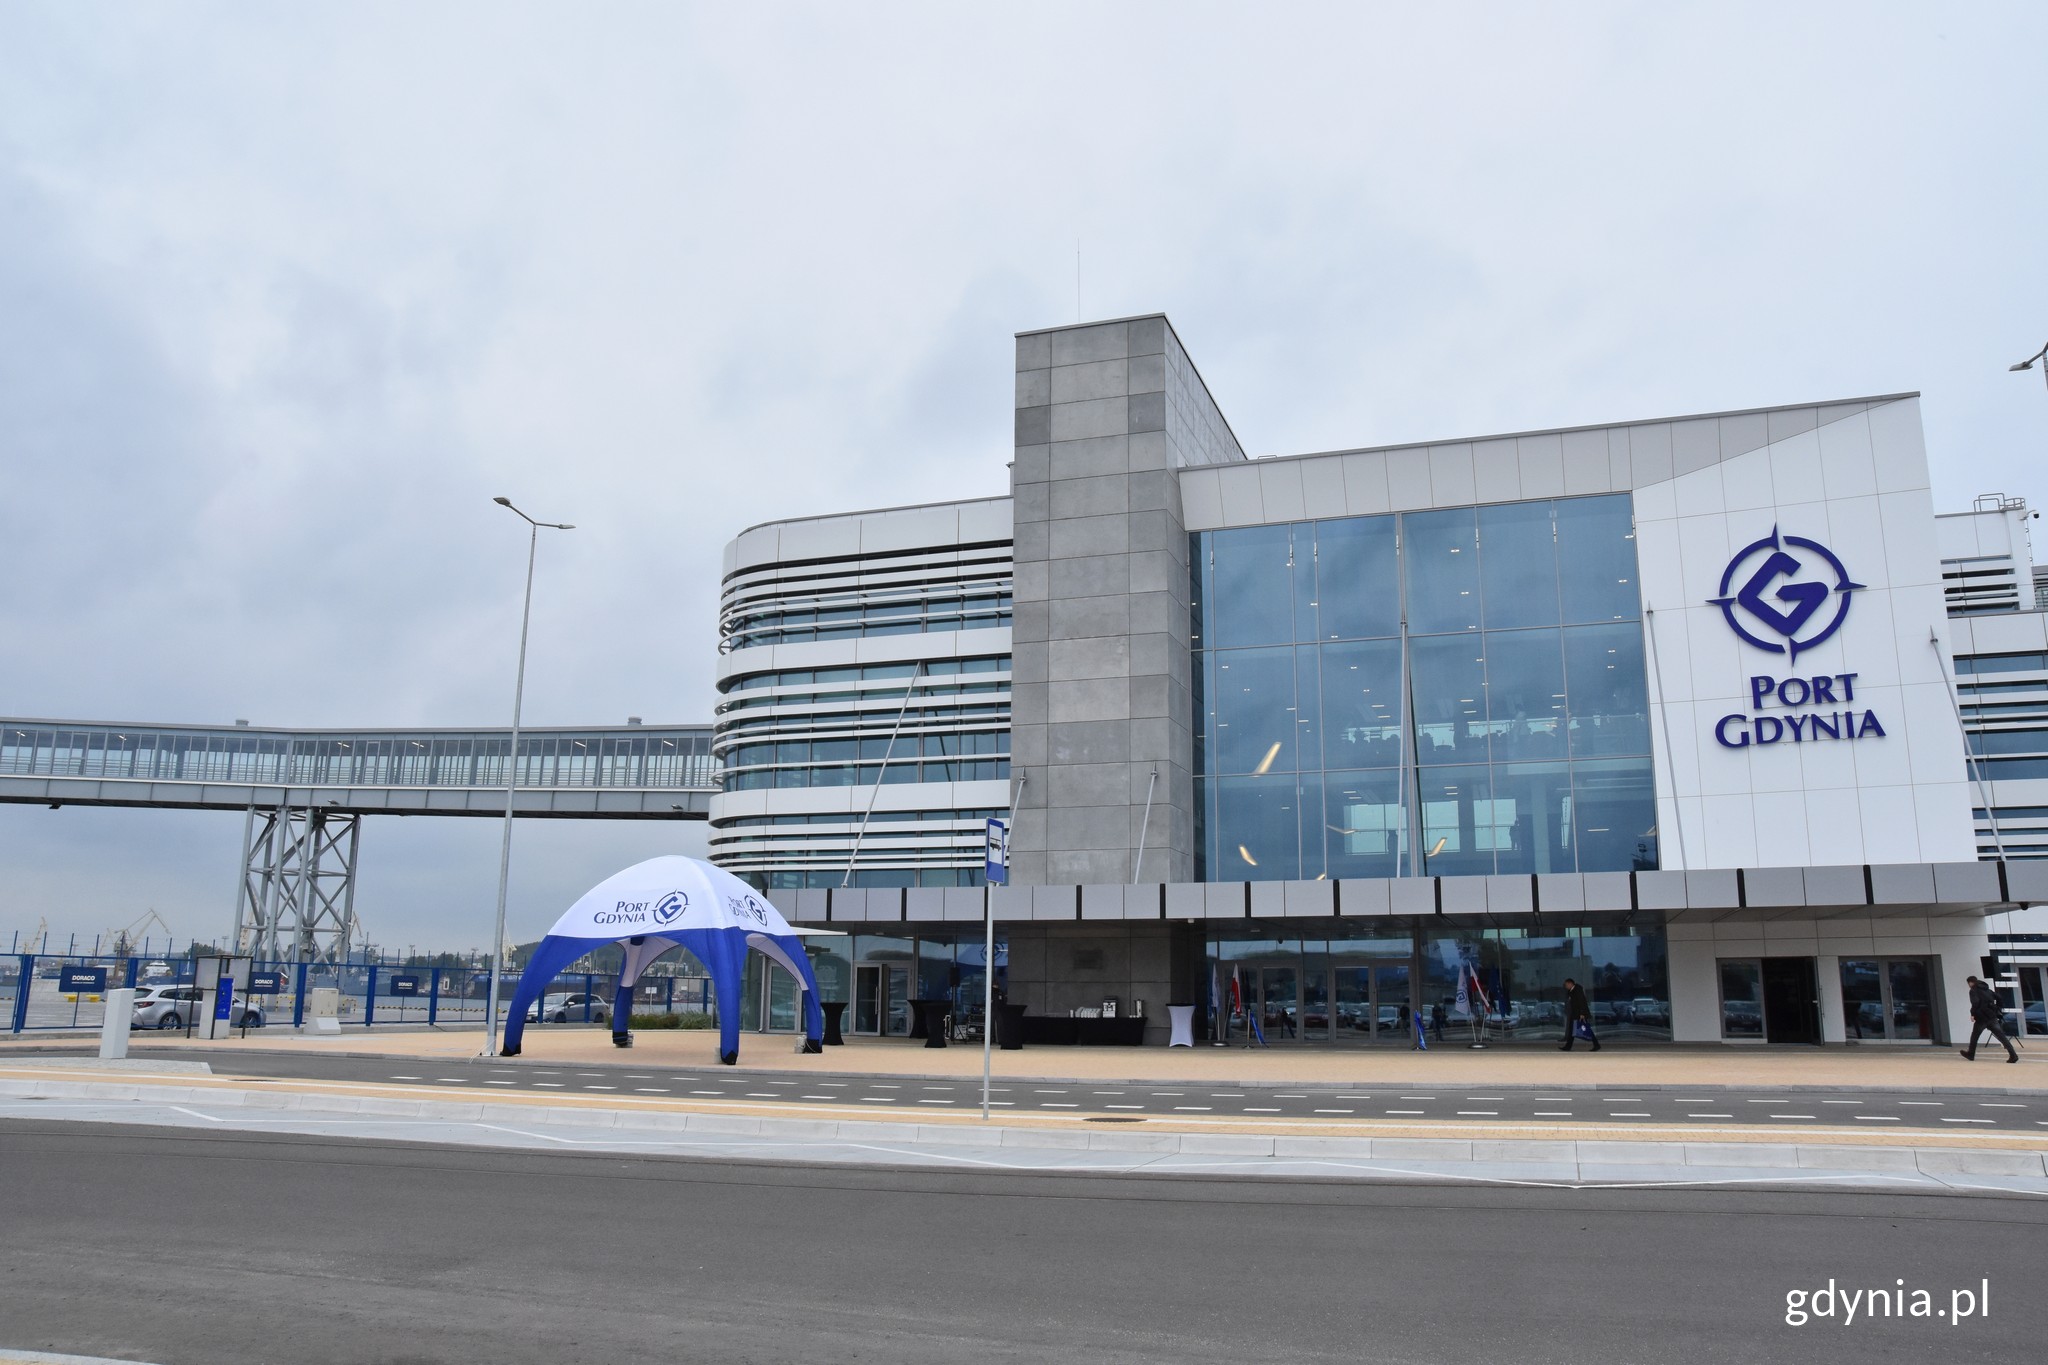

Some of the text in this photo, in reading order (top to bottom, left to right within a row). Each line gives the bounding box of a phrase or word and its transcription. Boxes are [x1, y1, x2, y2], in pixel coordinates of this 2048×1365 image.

[1750, 673, 1858, 710] PORT
[1714, 709, 1887, 749] GDYNIA
[593, 911, 646, 925] GDYNIA
[615, 901, 650, 913] PORT
